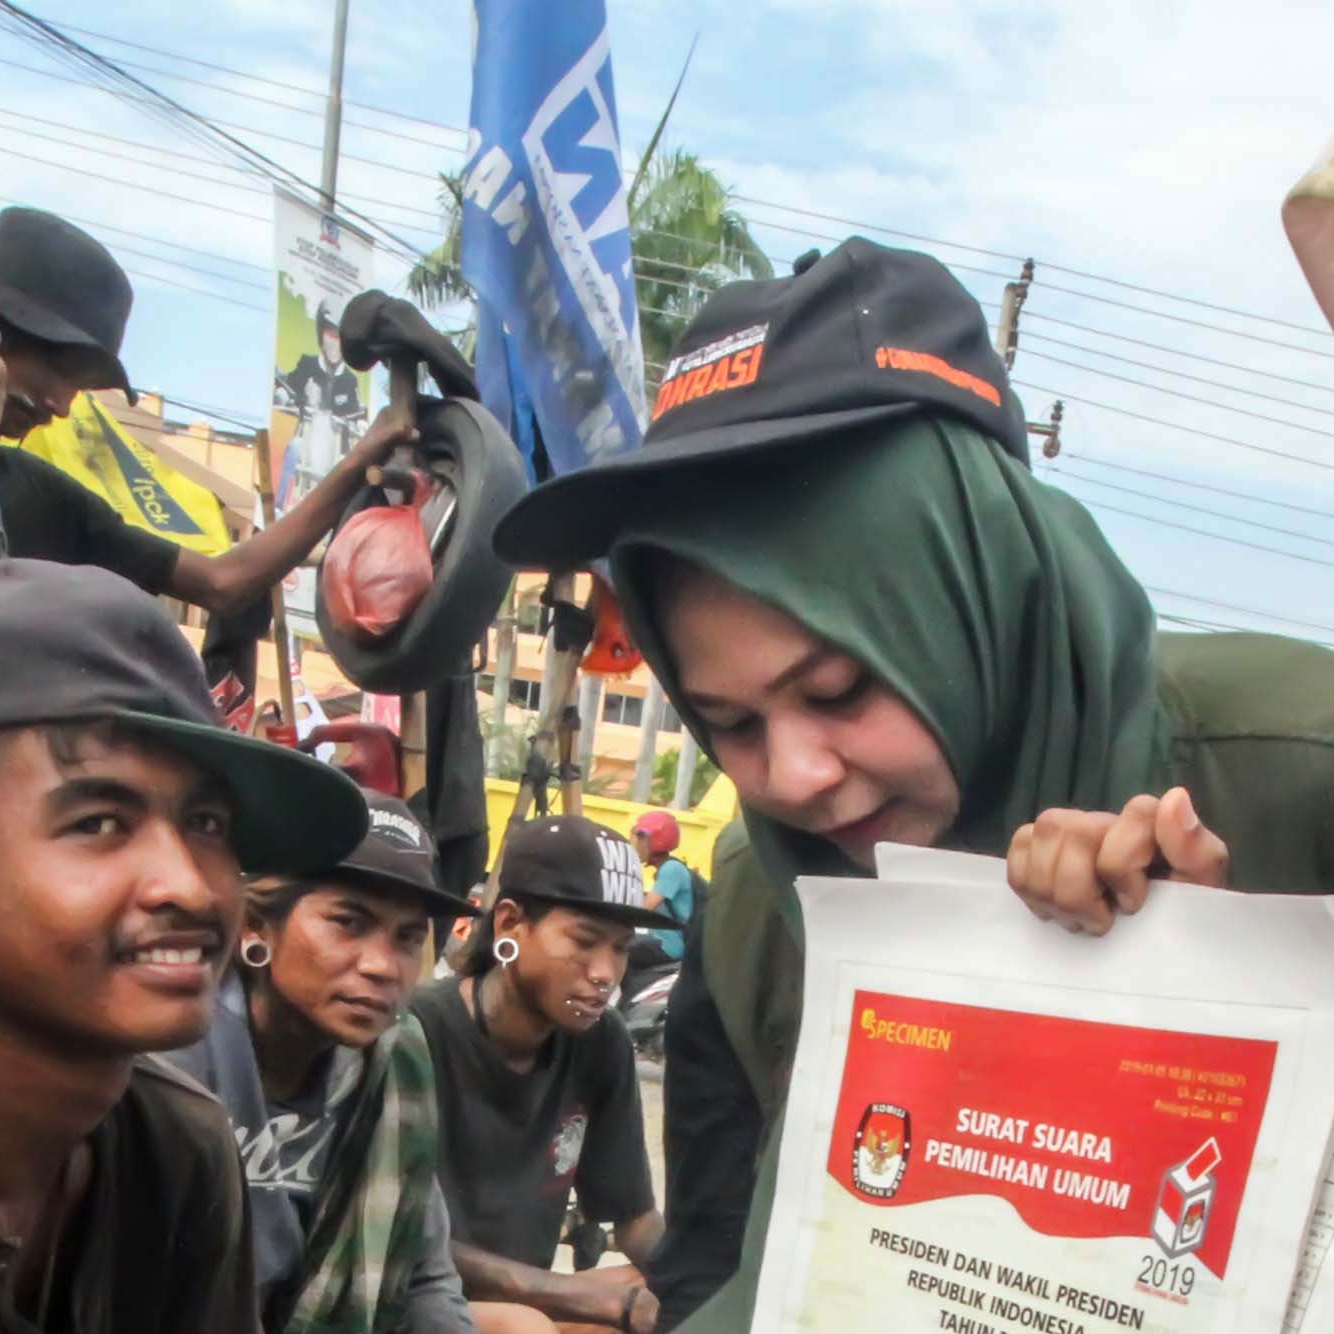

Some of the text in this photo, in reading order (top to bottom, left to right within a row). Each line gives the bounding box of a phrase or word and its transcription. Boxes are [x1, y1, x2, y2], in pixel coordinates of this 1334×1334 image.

[867, 1018, 952, 1052] SPECIMEN
[955, 1107, 1112, 1163] SURAT SUARA
[924, 1138, 1131, 1210] PEMILIHAN UMUM
[869, 1227, 950, 1268] PRESIDEN
[952, 1252, 993, 1281] DAN
[996, 1264, 1051, 1300] WAKIL
[1055, 1283, 1144, 1330] PRESIDEN
[907, 1269, 987, 1311] REPUBLIK
[1137, 1254, 1195, 1296] 2019
